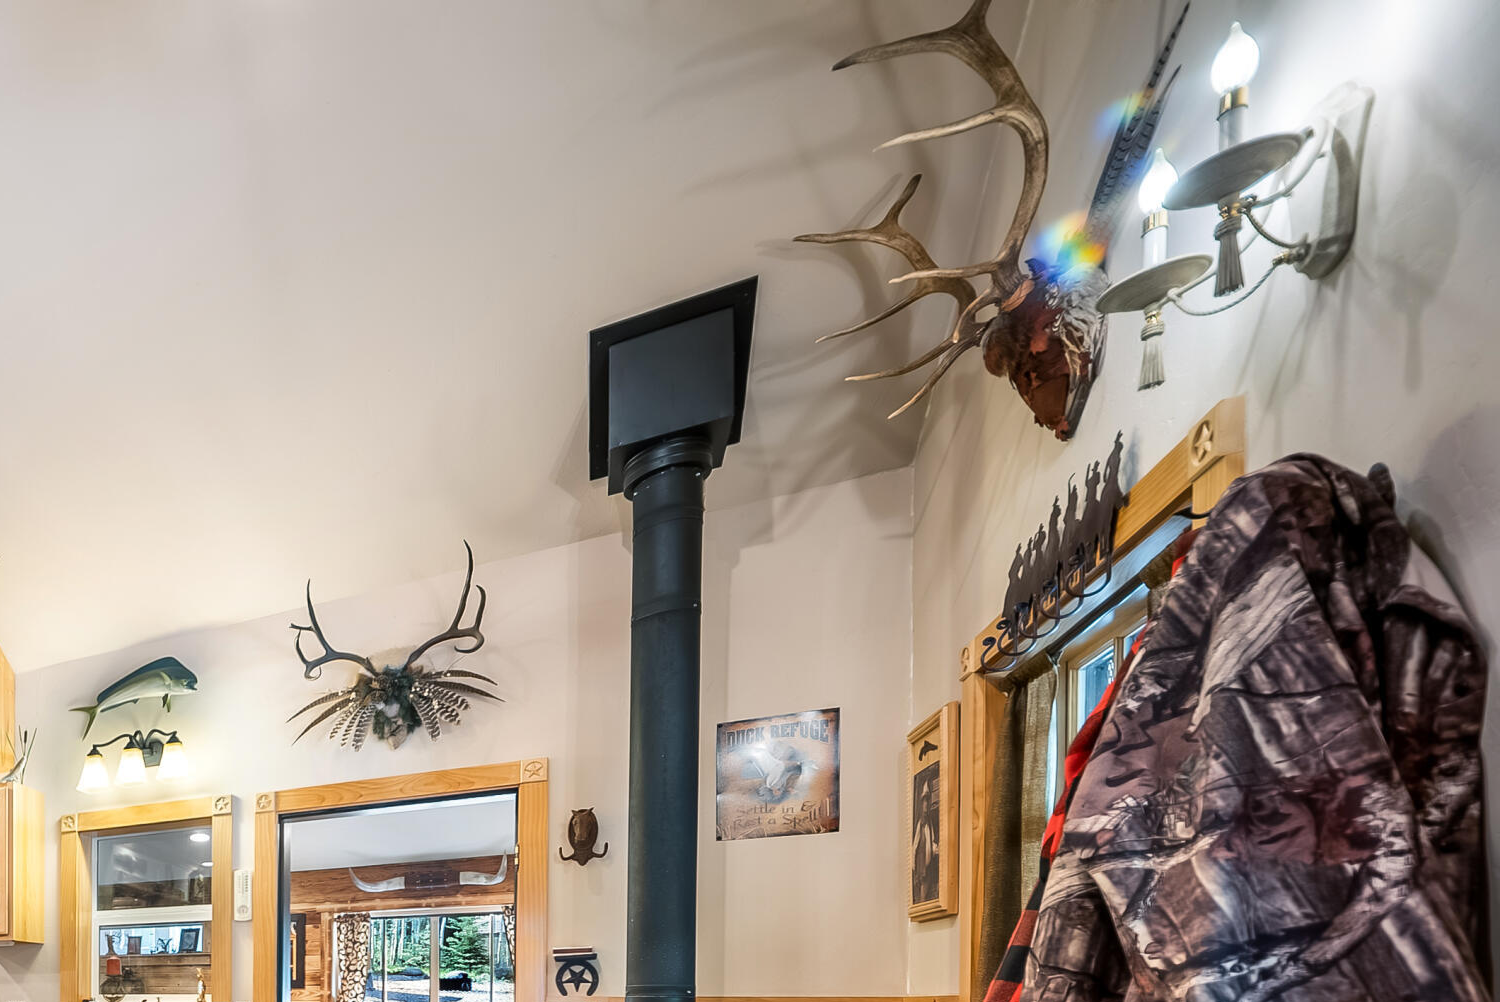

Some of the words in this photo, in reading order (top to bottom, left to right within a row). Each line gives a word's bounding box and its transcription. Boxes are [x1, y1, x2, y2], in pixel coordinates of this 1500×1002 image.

[726, 726, 765, 753] DUCK
[770, 719, 830, 744] REFUGE
[782, 806, 795, 814] in
[801, 800, 817, 812] &
